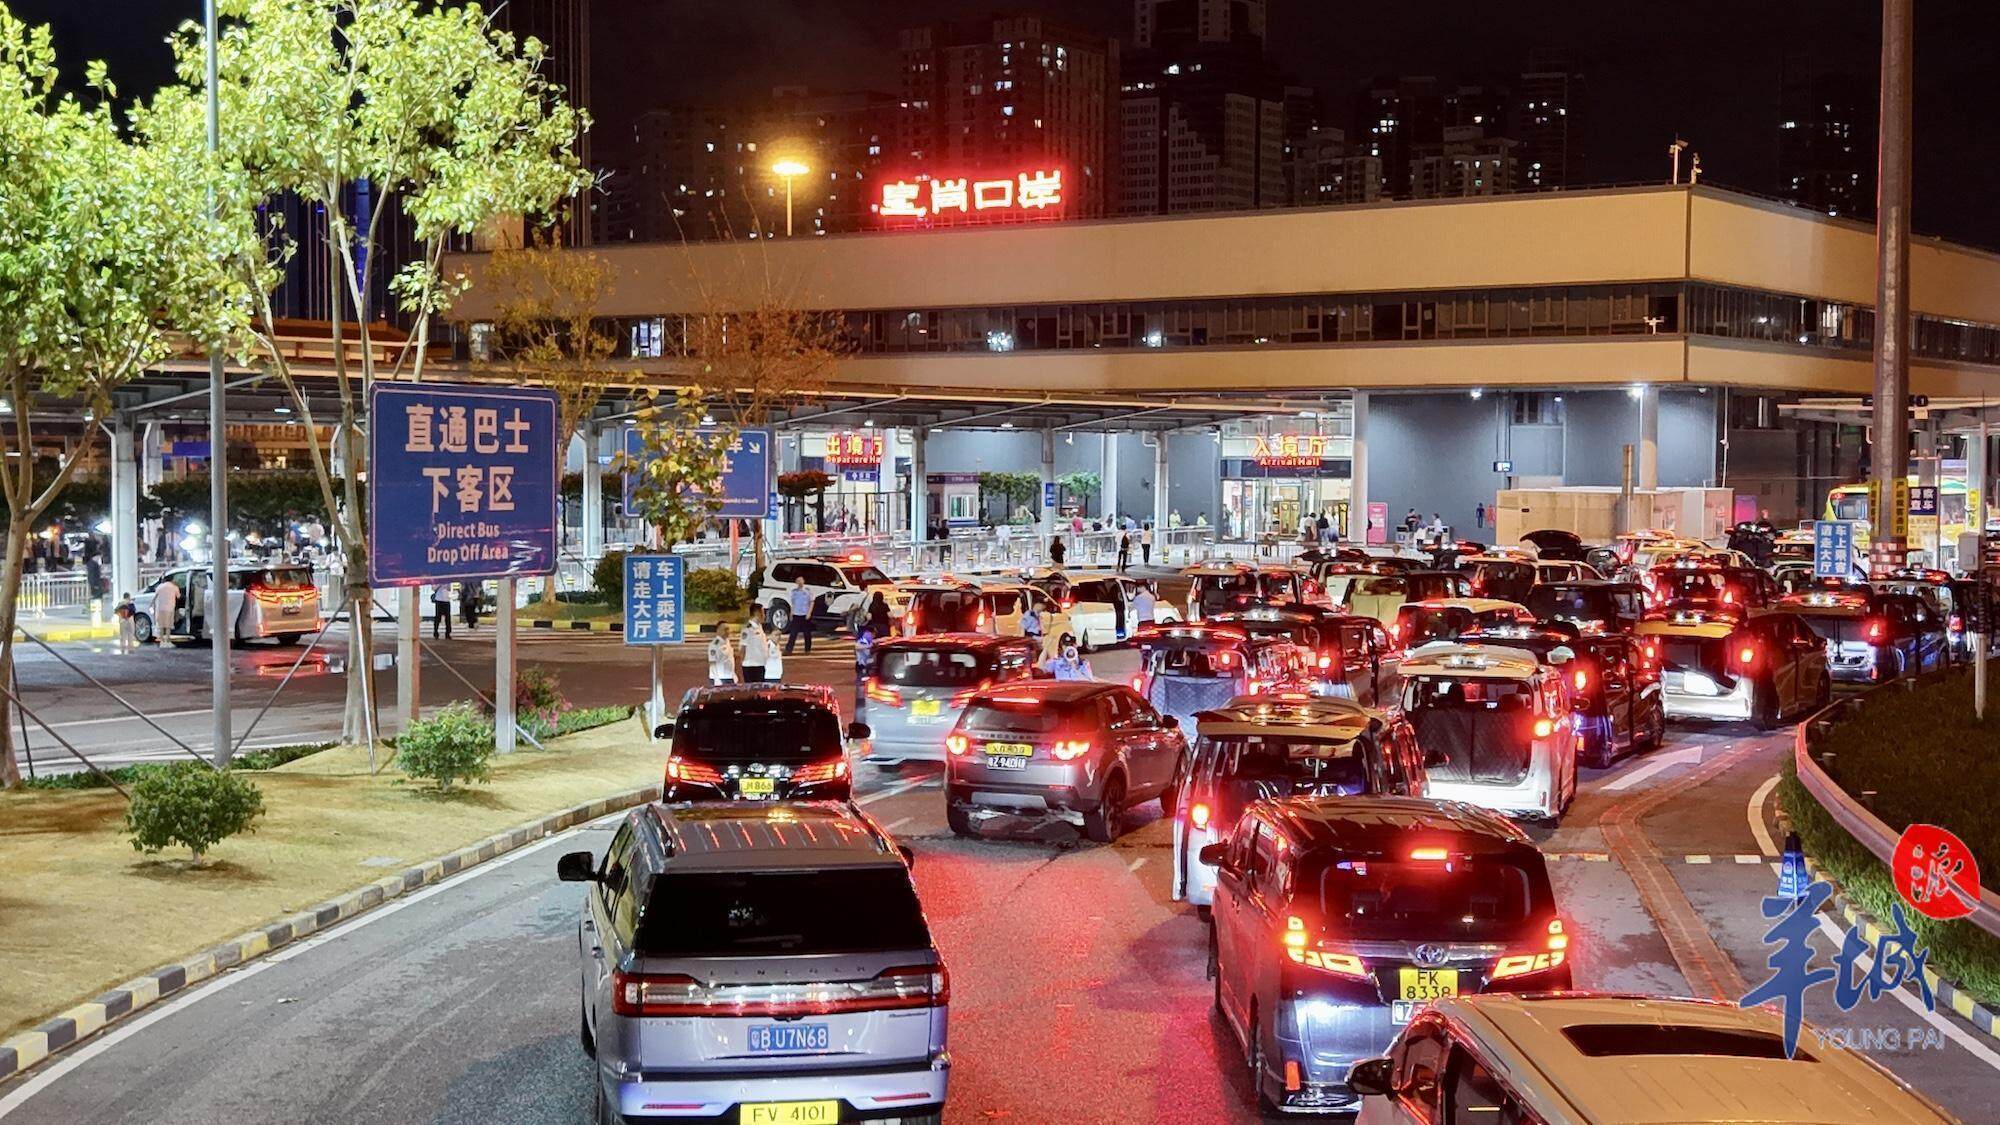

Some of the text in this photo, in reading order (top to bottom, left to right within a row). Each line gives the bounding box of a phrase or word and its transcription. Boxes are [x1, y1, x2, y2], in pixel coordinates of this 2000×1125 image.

[880, 170, 1061, 216] 皇岗口岸
[404, 403, 530, 454] 直通巴士
[826, 434, 882, 456] 出境厅
[1252, 434, 1328, 458] 入境厅
[826, 455, 868, 464] Departure
[1260, 457, 1320, 466] Arrival Hall
[422, 464, 515, 513] 下客区
[438, 521, 500, 539] Direct Bus
[428, 543, 509, 564] Drop Off Area
[632, 561, 651, 639] 请走大厅
[656, 560, 675, 639] 车上乘客
[1417, 971, 1439, 985] FK
[753, 1105, 826, 1122] FV 4101
